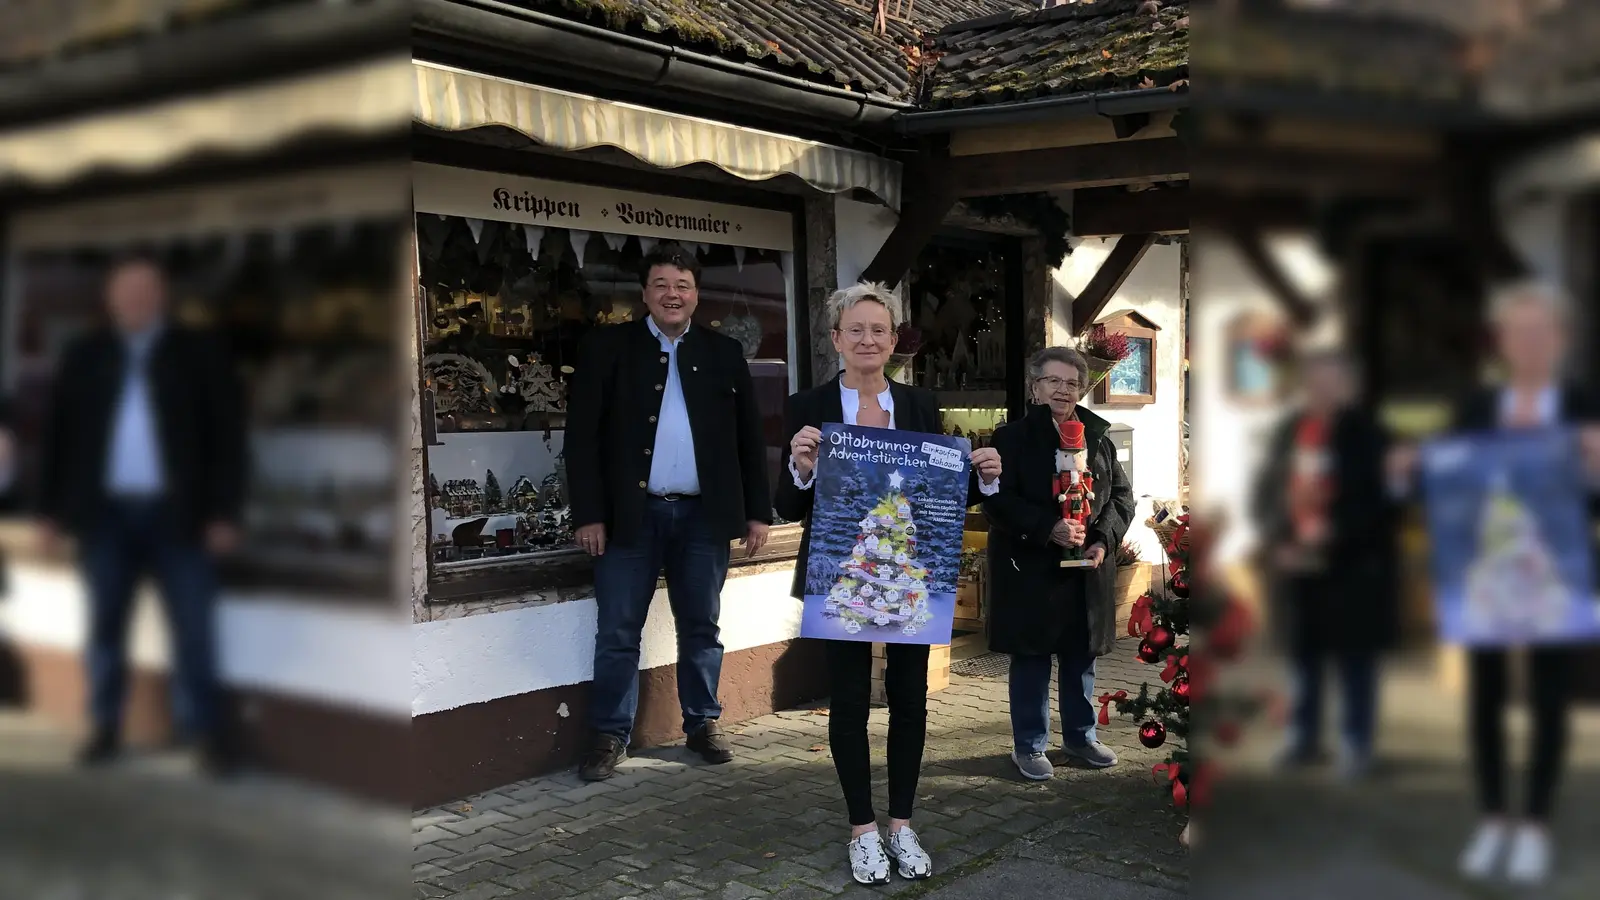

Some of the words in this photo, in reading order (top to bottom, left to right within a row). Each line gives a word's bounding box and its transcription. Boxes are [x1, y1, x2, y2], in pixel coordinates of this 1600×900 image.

[493, 188, 580, 220] Krippen
[616, 202, 730, 234] Vordermaier
[830, 432, 918, 453] Ottobrunner
[923, 444, 958, 459] Einkaufen
[828, 448, 928, 468] Adventstürchen
[931, 457, 963, 470] dahoam!
